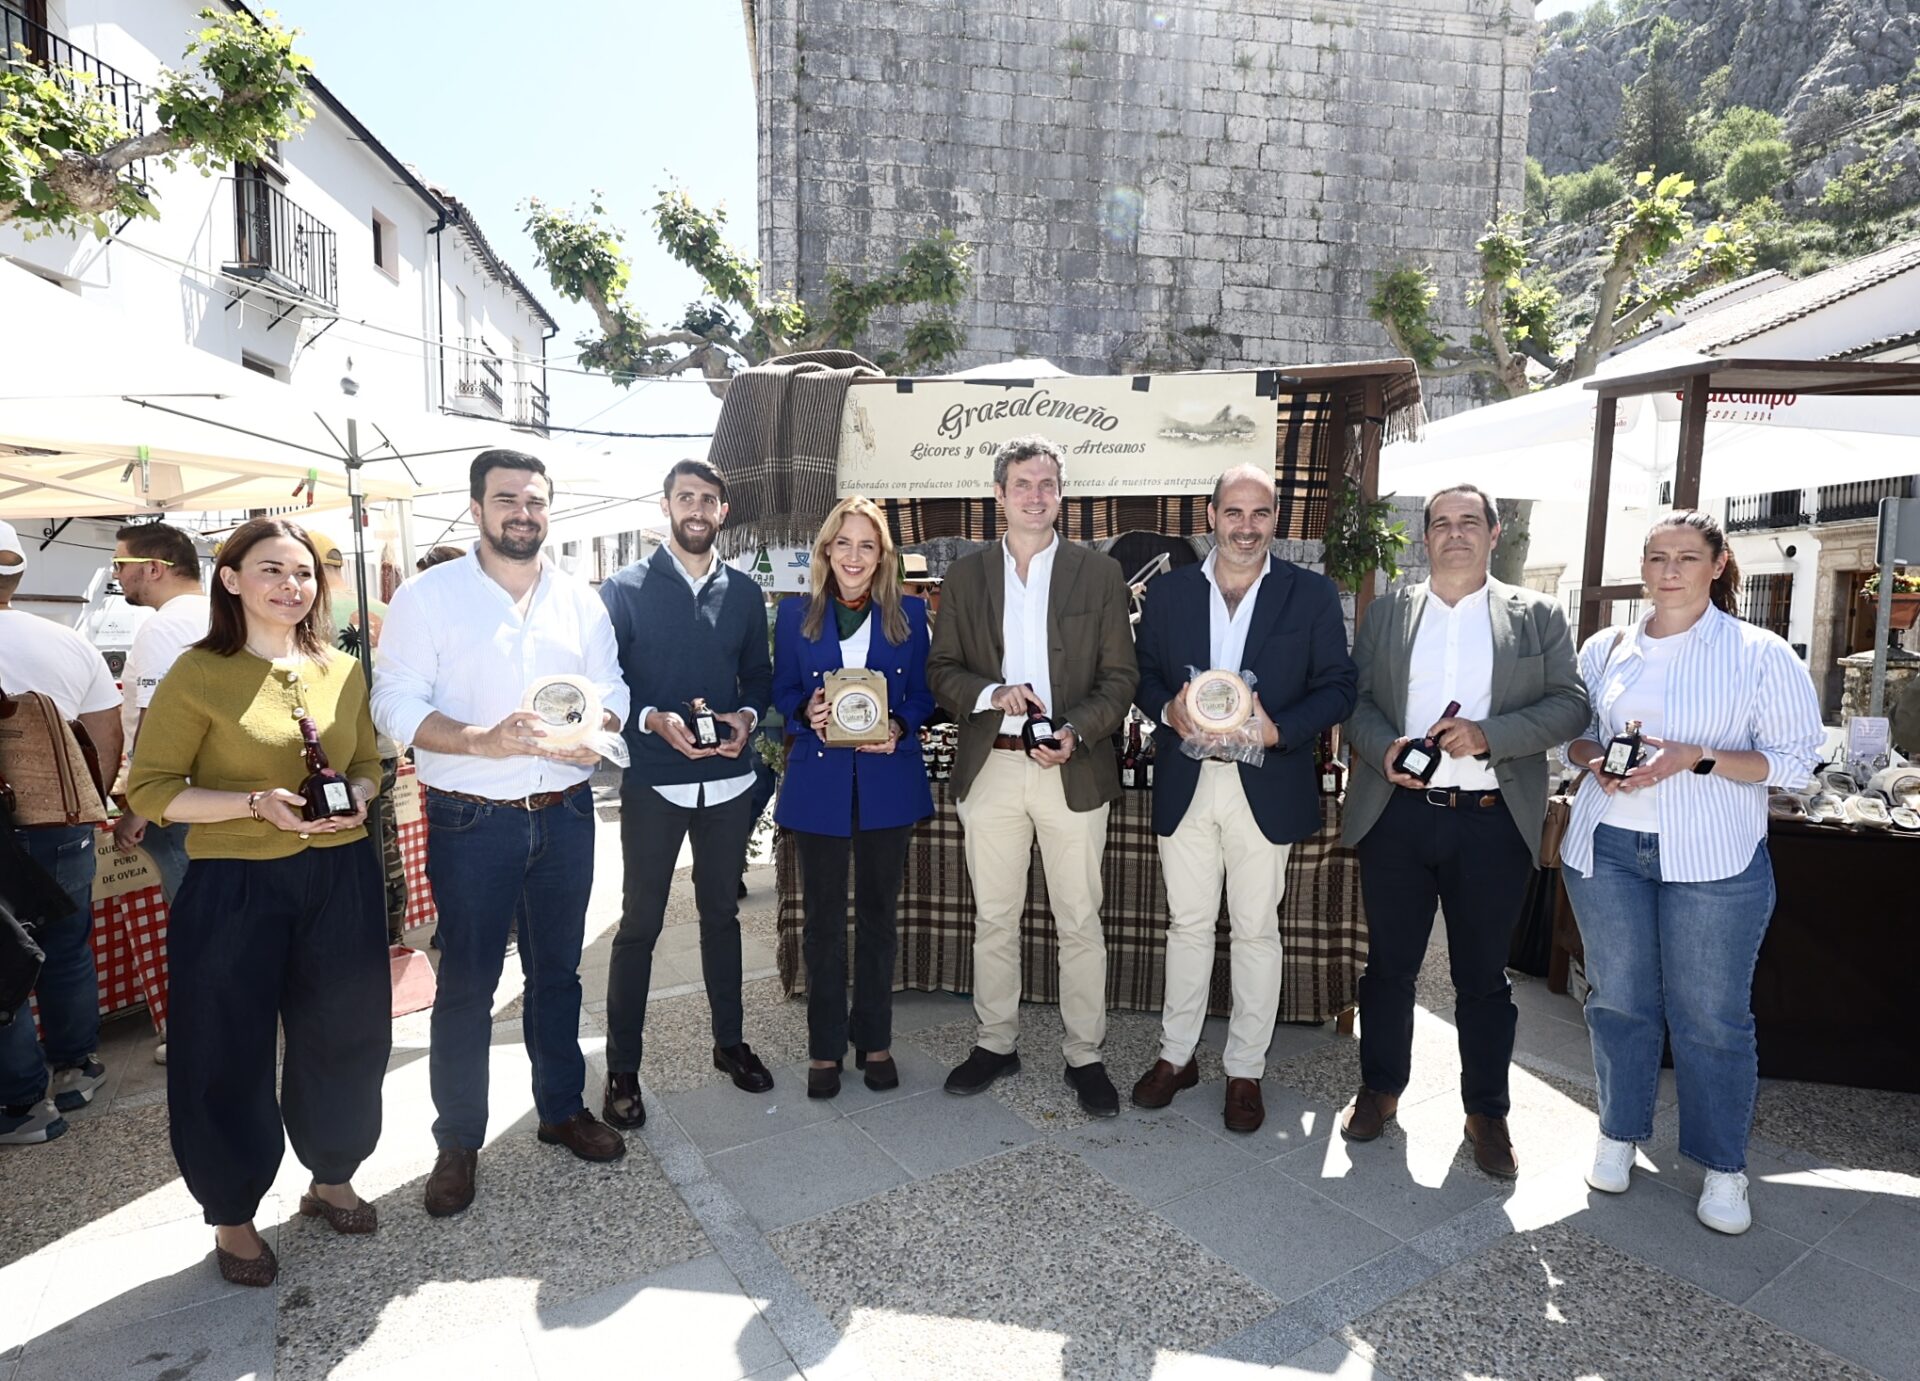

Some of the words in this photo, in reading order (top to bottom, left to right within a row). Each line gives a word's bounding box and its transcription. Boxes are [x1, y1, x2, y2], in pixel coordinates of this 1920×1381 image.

[937, 389, 1119, 440] Grazalemeño
[910, 442, 961, 461] Licores
[963, 445, 975, 459] y
[1072, 439, 1146, 454] Artesanos
[839, 479, 889, 490] Elaborados
[909, 478, 953, 491] productos
[956, 479, 980, 489] 100%
[1073, 477, 1106, 487] recetas
[1107, 476, 1119, 487] de
[1121, 477, 1161, 487] nuestros
[113, 854, 138, 867] PURO
[102, 874, 116, 885] DE
[117, 866, 148, 880] OVEJA
